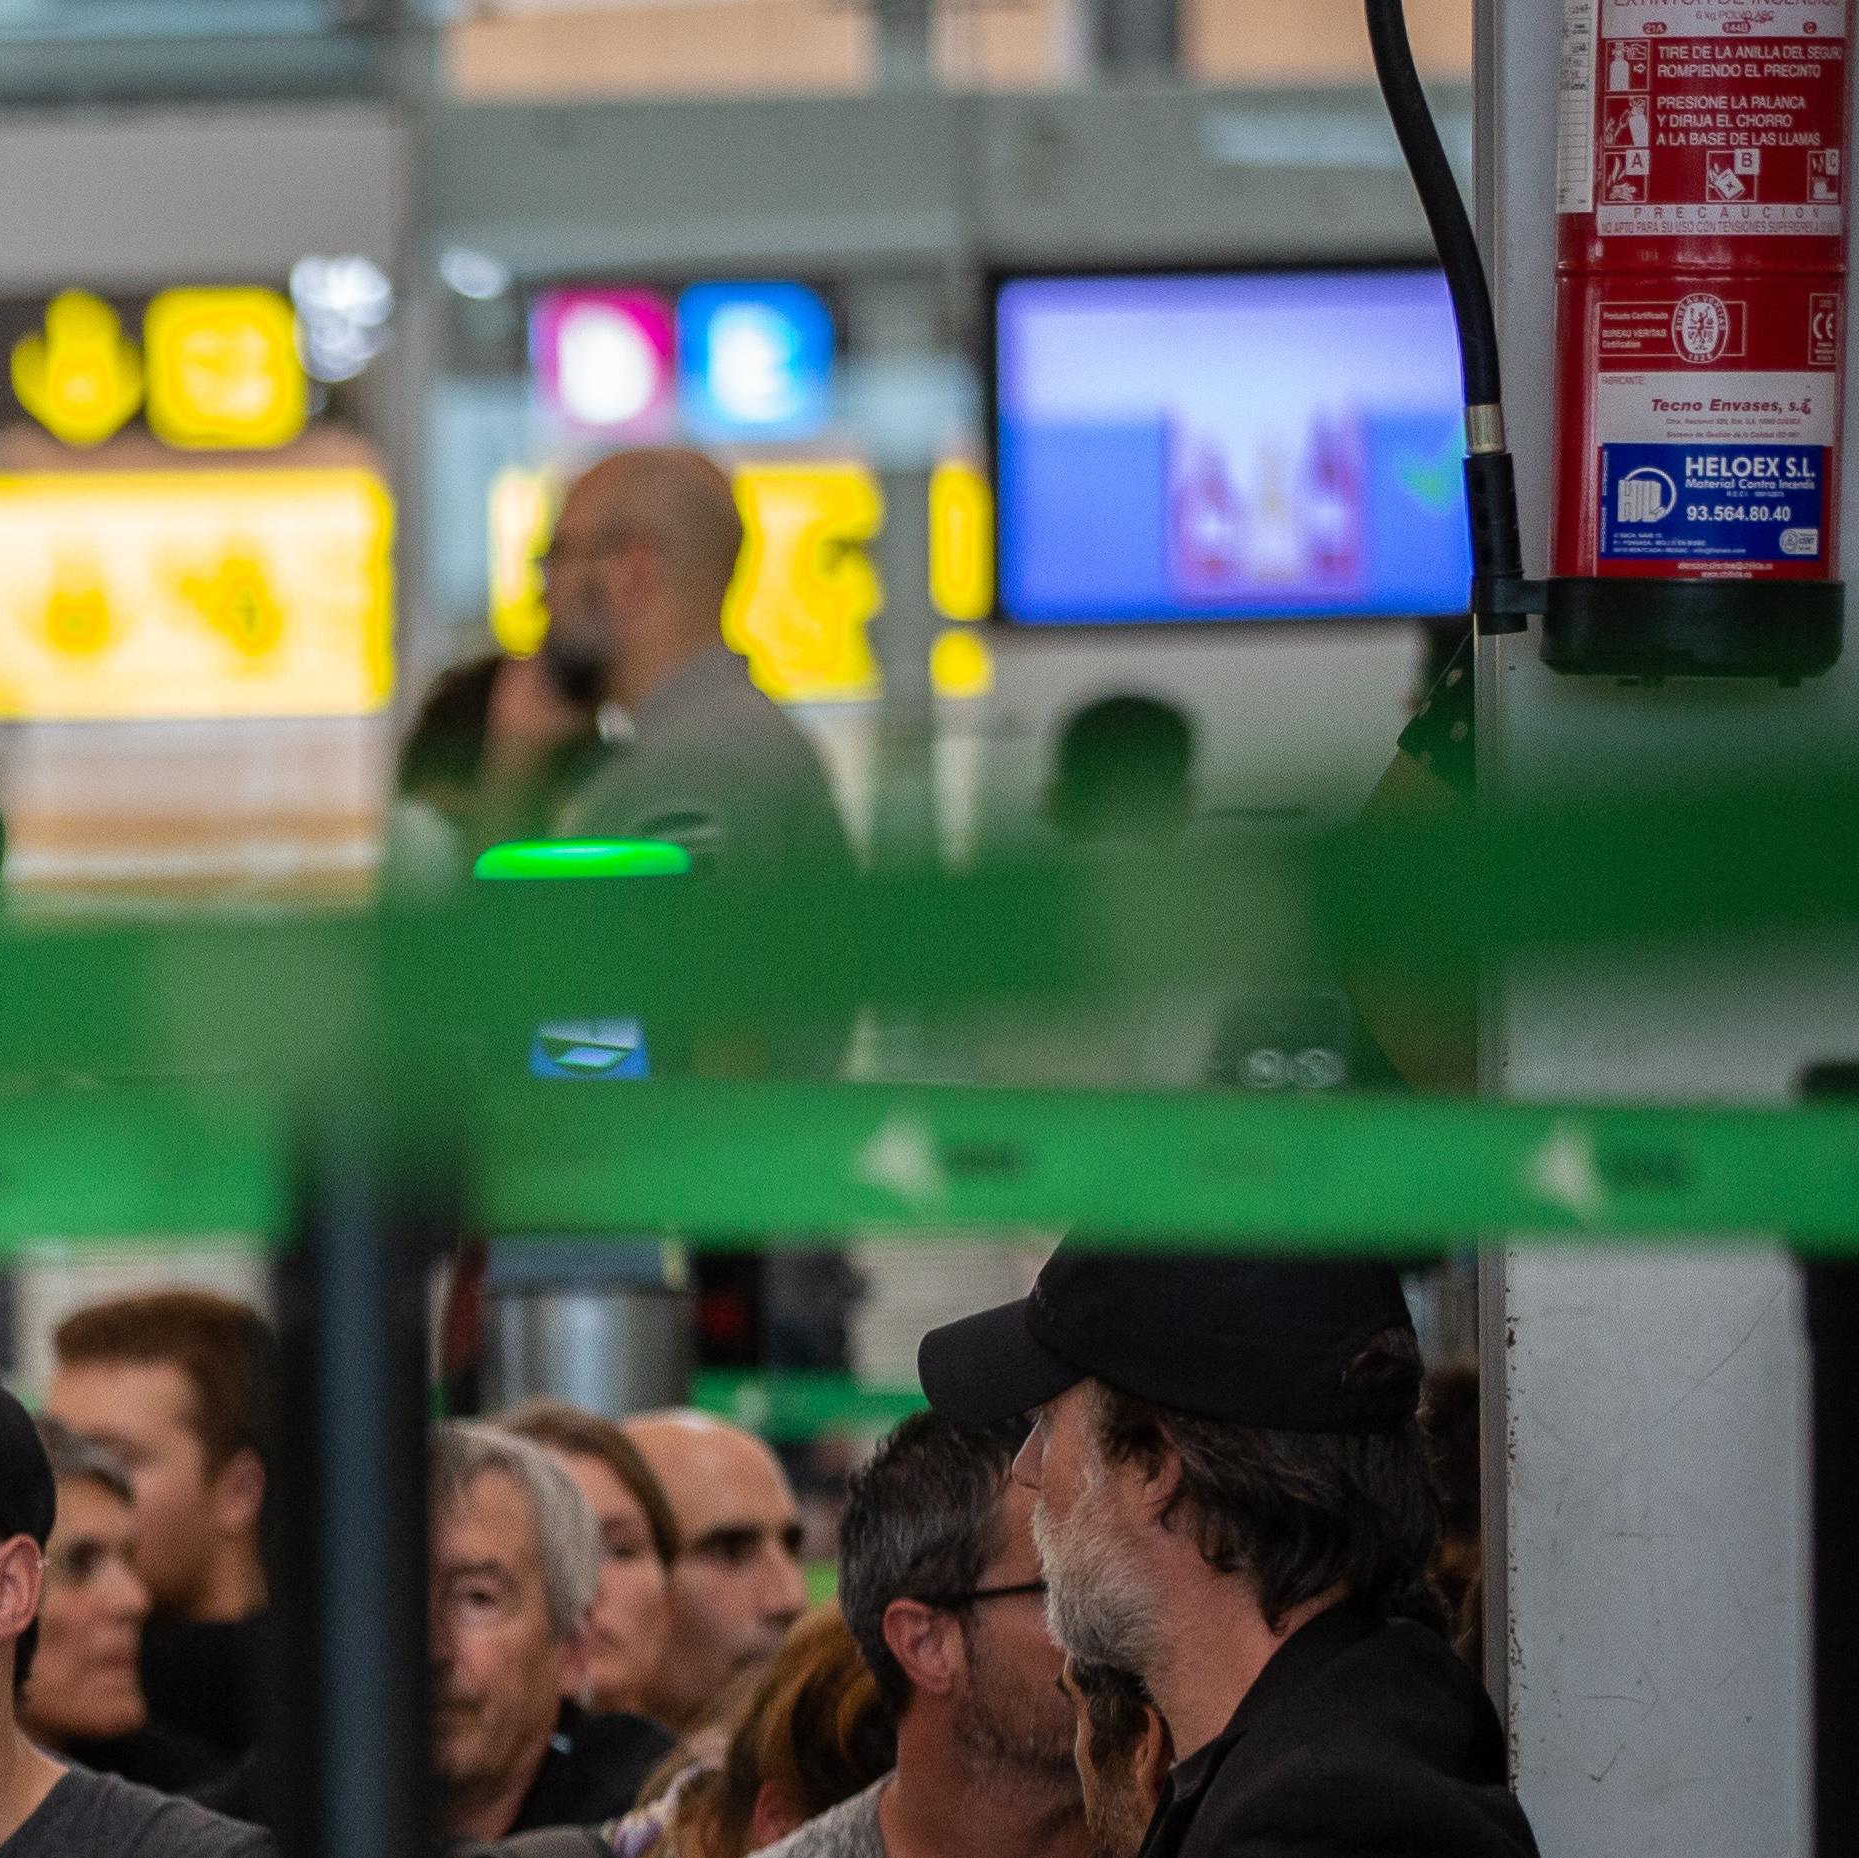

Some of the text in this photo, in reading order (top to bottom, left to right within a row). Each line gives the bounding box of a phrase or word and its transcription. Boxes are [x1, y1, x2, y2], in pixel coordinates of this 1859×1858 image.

[1658, 46, 1690, 60] TIRE
[1693, 46, 1712, 60] DE
[1715, 46, 1732, 60] LA
[1735, 46, 1780, 60] ANILLA
[1783, 46, 1806, 60] DEL
[1657, 64, 1821, 78] ROMPIENDO EL PRECINTO
[1657, 96, 1805, 110] PRESIONE LA PALANCA
[1657, 114, 1792, 128] Y DIRIJA EL CHORRO
[1656, 132, 1820, 146] A LA BASE DE LAS LLAMAS
[1631, 153, 1643, 168] A
[1741, 152, 1753, 167] B
[1614, 221, 1633, 233] APTO
[1636, 221, 1659, 233] PARA
[1661, 221, 1673, 233] SU
[1675, 221, 1694, 233] USO
[1696, 221, 1717, 233] CON
[1717, 221, 1766, 233] TENSIONES
[1651, 399, 1701, 412] Tecno
[1709, 399, 1782, 414] Envases,
[1685, 456, 1816, 478] HELOEX S.L.
[1685, 479, 1735, 489] Material
[1738, 479, 1777, 489] Contra
[1686, 505, 1791, 522] 93.564.80.40
